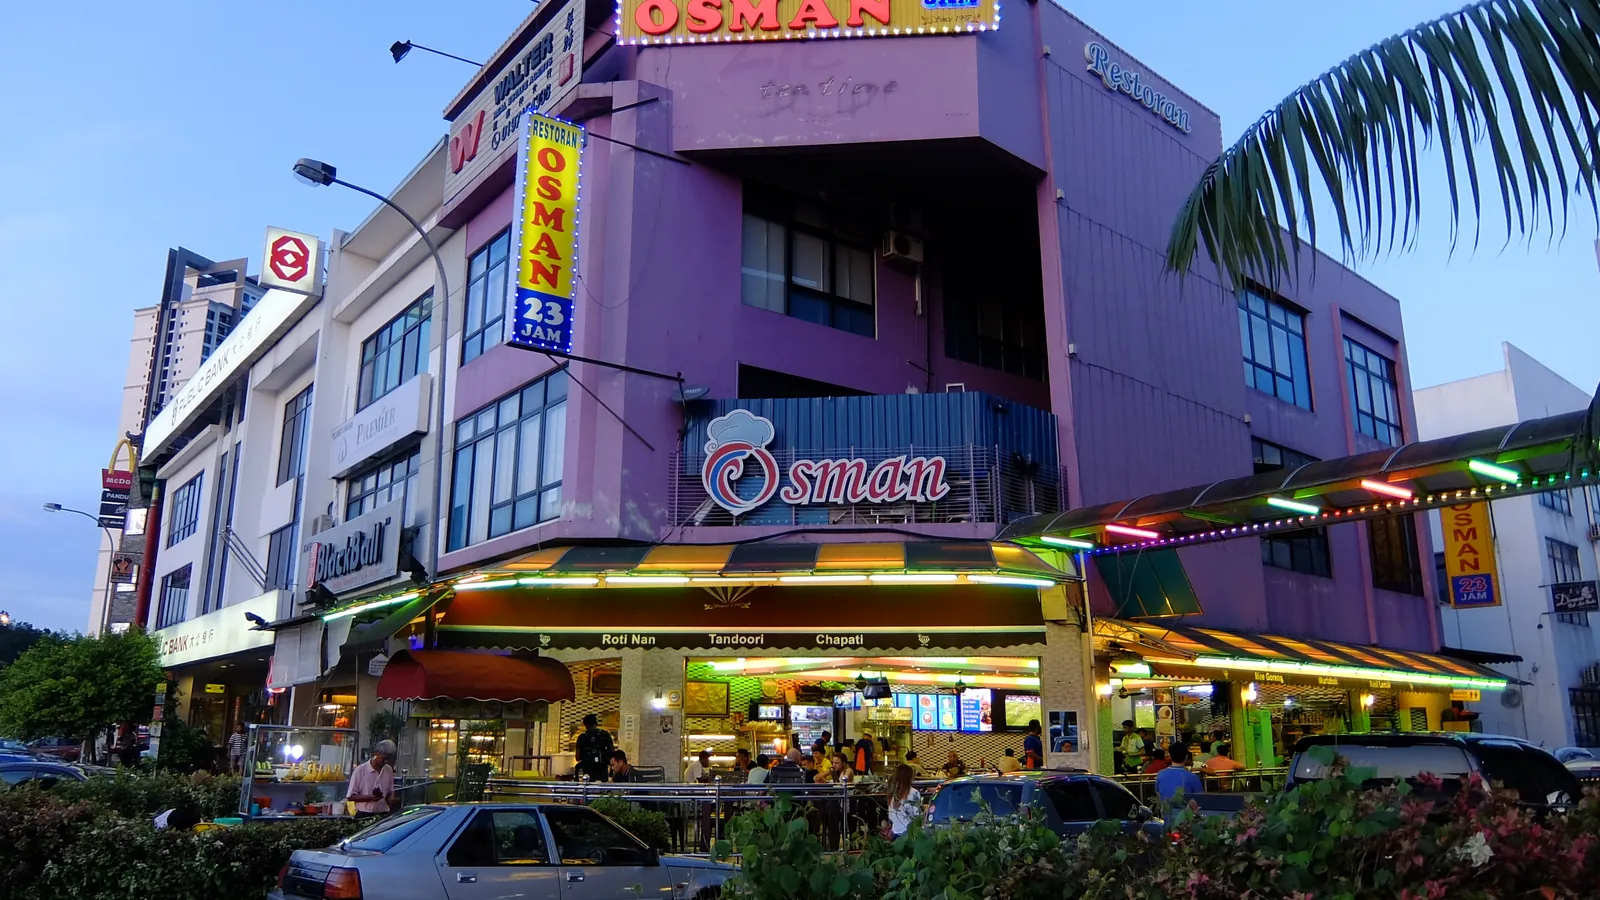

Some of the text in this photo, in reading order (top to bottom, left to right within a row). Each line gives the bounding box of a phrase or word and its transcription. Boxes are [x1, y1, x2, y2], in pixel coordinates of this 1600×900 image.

[634, 0, 891, 35] OSMAN
[494, 32, 554, 106] WALTER
[1084, 41, 1192, 134] Restoran
[450, 110, 485, 174] W
[533, 119, 577, 149] RESTORAN
[529, 147, 566, 290] OSMAN
[522, 297, 564, 326] 23
[521, 323, 562, 344] JAM
[702, 441, 951, 517] Osman
[1459, 576, 1488, 594] 23
[1460, 592, 1488, 602] JAM
[168, 634, 189, 655] BANK
[602, 634, 656, 645] Roti Nan
[709, 634, 764, 645] Tandoori
[815, 634, 864, 647] Chapati
[1265, 672, 1284, 684] Goreng
